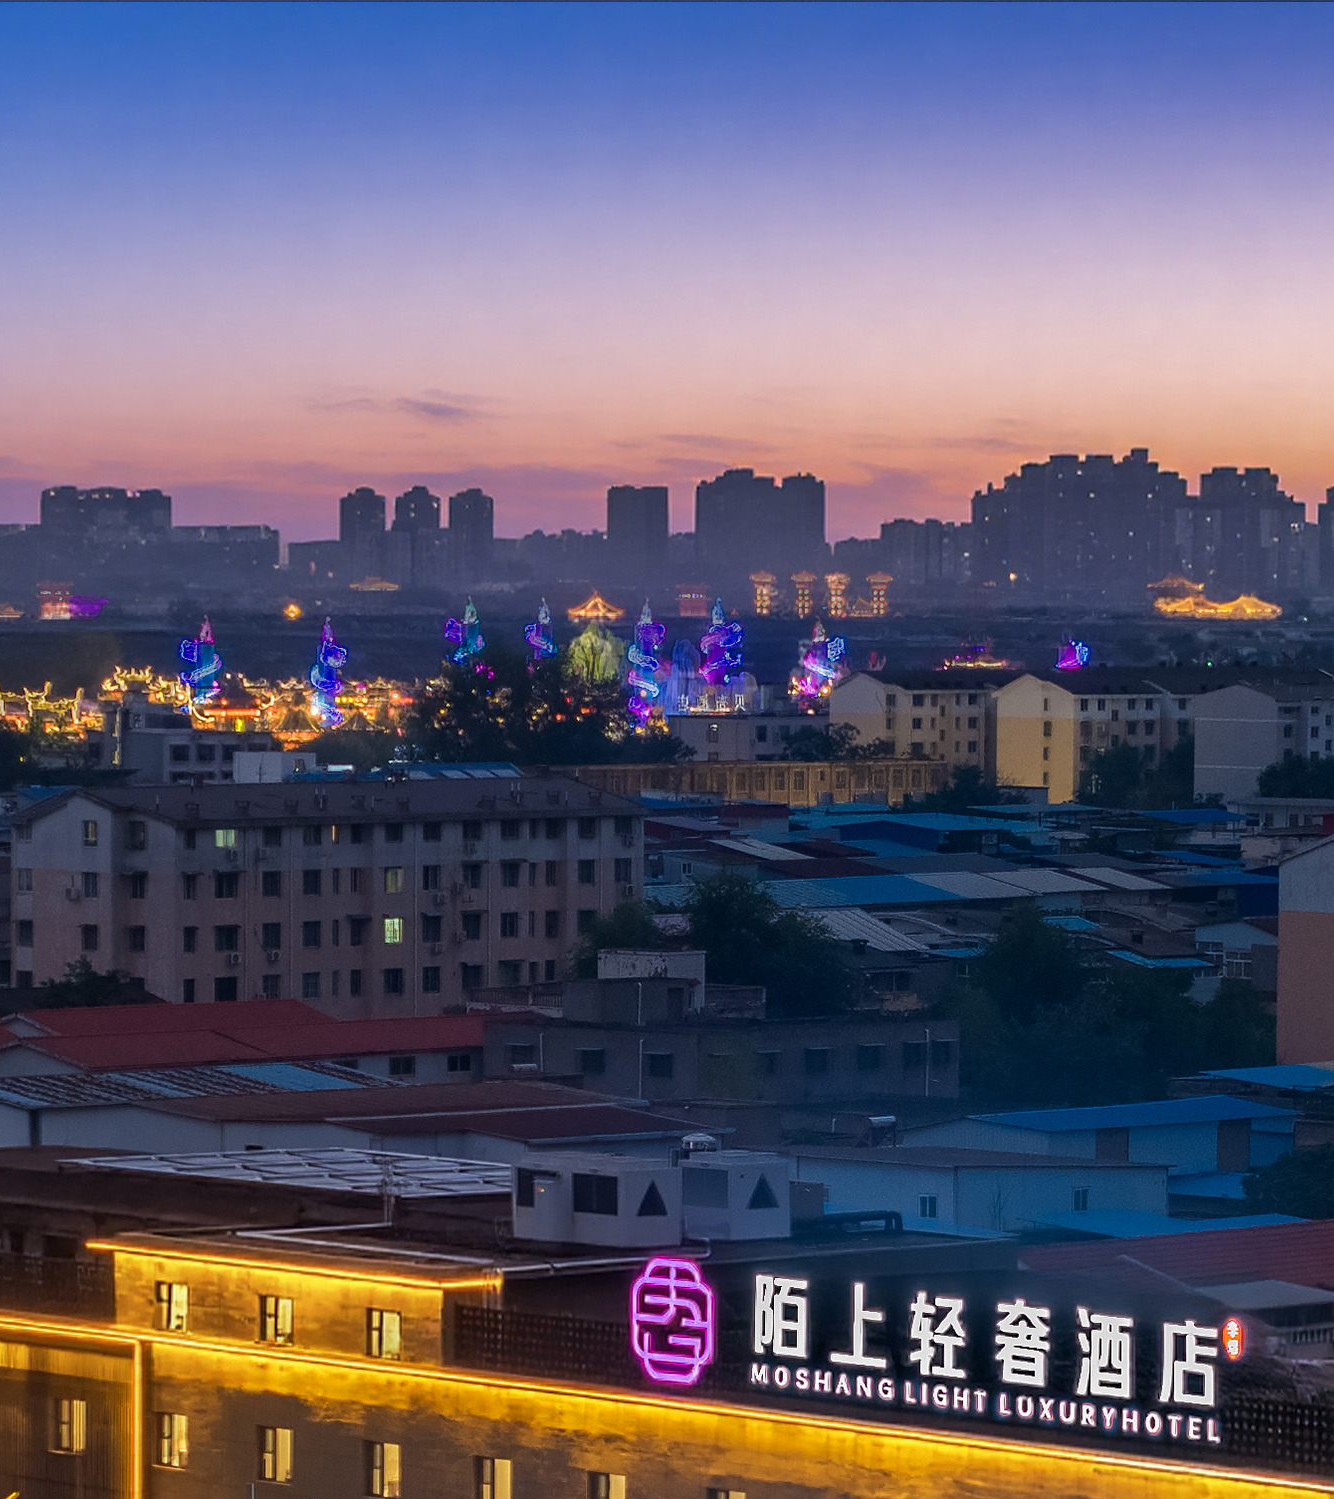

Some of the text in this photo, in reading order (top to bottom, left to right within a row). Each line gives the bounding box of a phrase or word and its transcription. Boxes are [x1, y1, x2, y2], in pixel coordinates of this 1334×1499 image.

[754, 1274, 1218, 1406] 陌上轻奢酒店
[750, 1363, 894, 1399] MOSHANG
[904, 1381, 987, 1413] LIGHT
